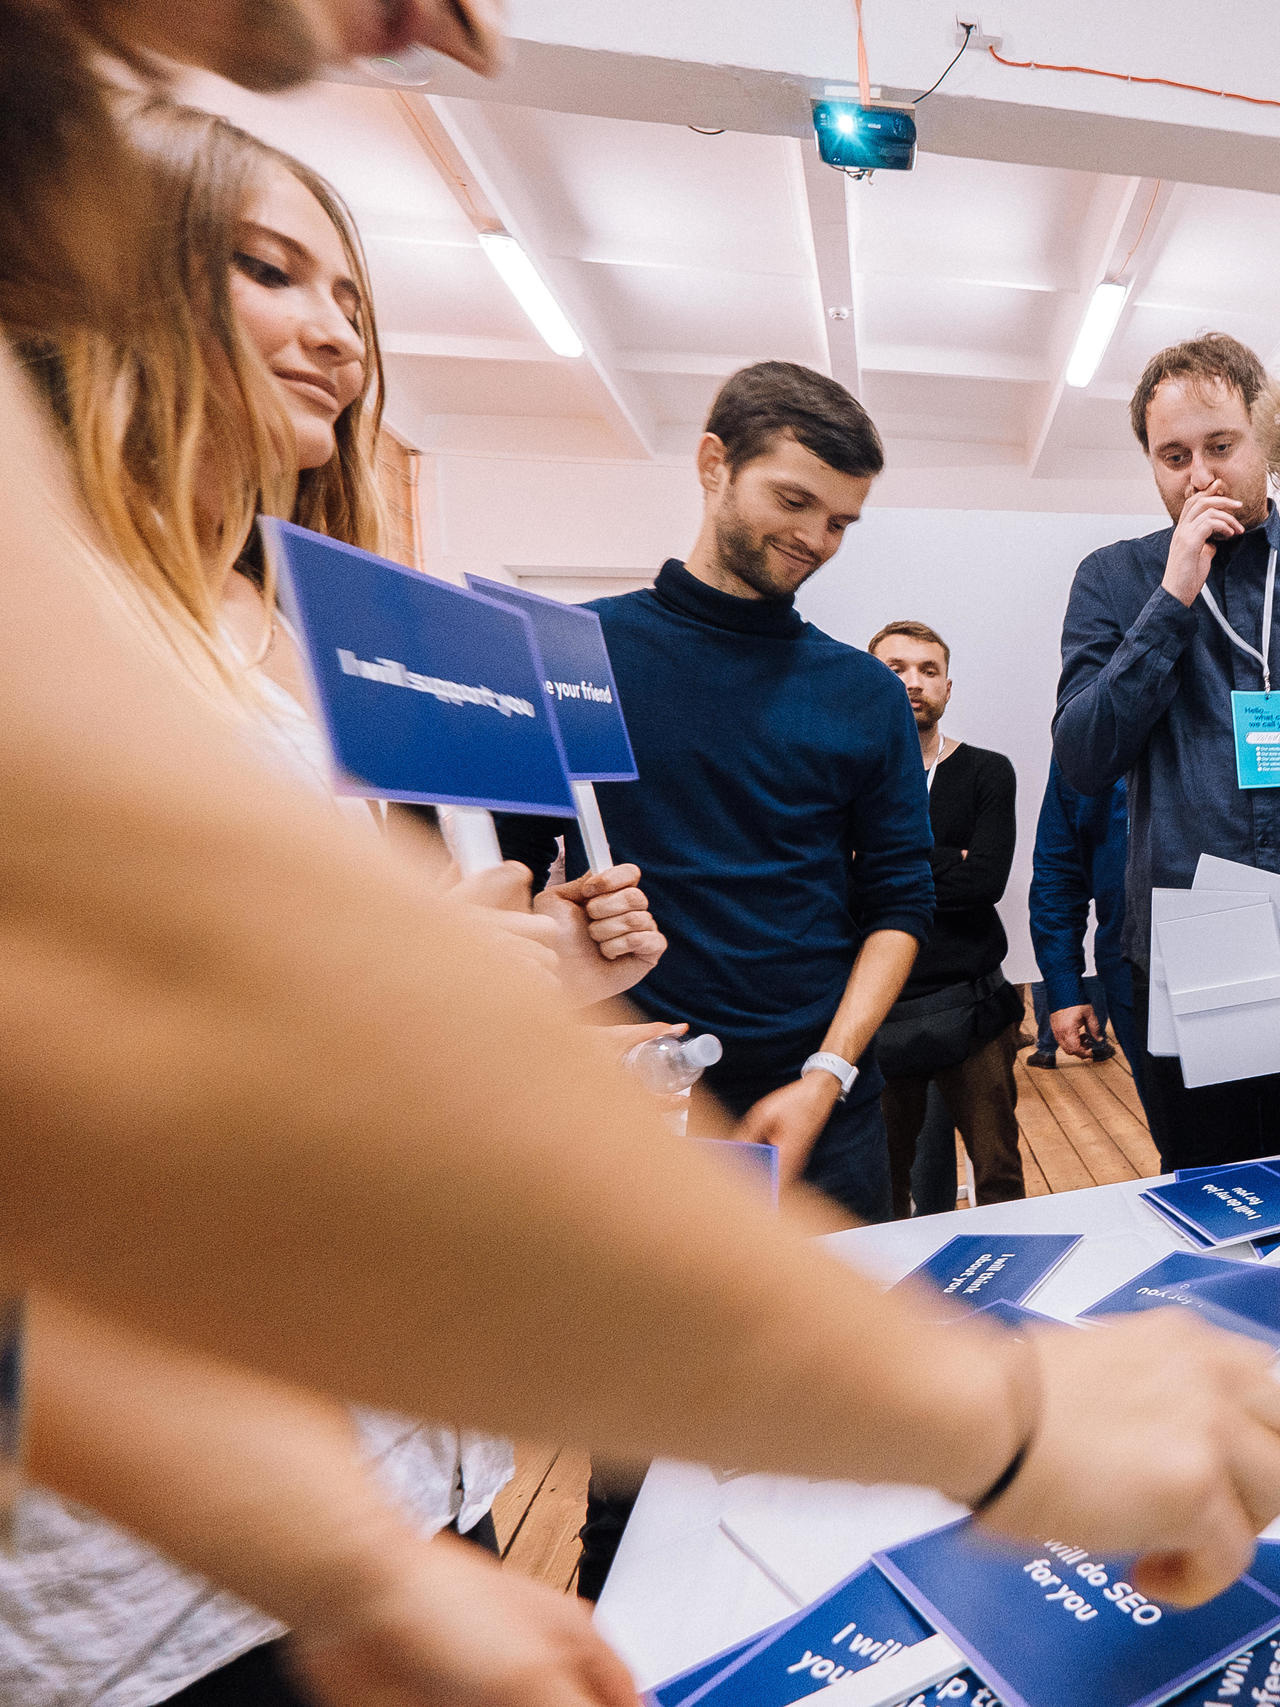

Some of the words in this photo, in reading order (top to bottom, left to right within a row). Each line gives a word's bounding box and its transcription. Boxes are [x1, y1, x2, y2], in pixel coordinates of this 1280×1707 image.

[554, 681, 580, 701] your
[580, 680, 613, 704] friend
[1231, 1187, 1255, 1198] you
[1245, 1195, 1264, 1205] for
[1226, 1198, 1242, 1207] do
[1232, 1205, 1257, 1217] will
[960, 1253, 992, 1277] about
[985, 1258, 1009, 1272] will
[943, 1277, 968, 1293] you
[962, 1272, 995, 1294] think
[1136, 1286, 1169, 1298] you
[1023, 1558, 1062, 1588] for
[1045, 1584, 1099, 1622] you
[1076, 1562, 1108, 1587] do
[1103, 1581, 1162, 1626] SEO
[831, 1622, 857, 1645] I
